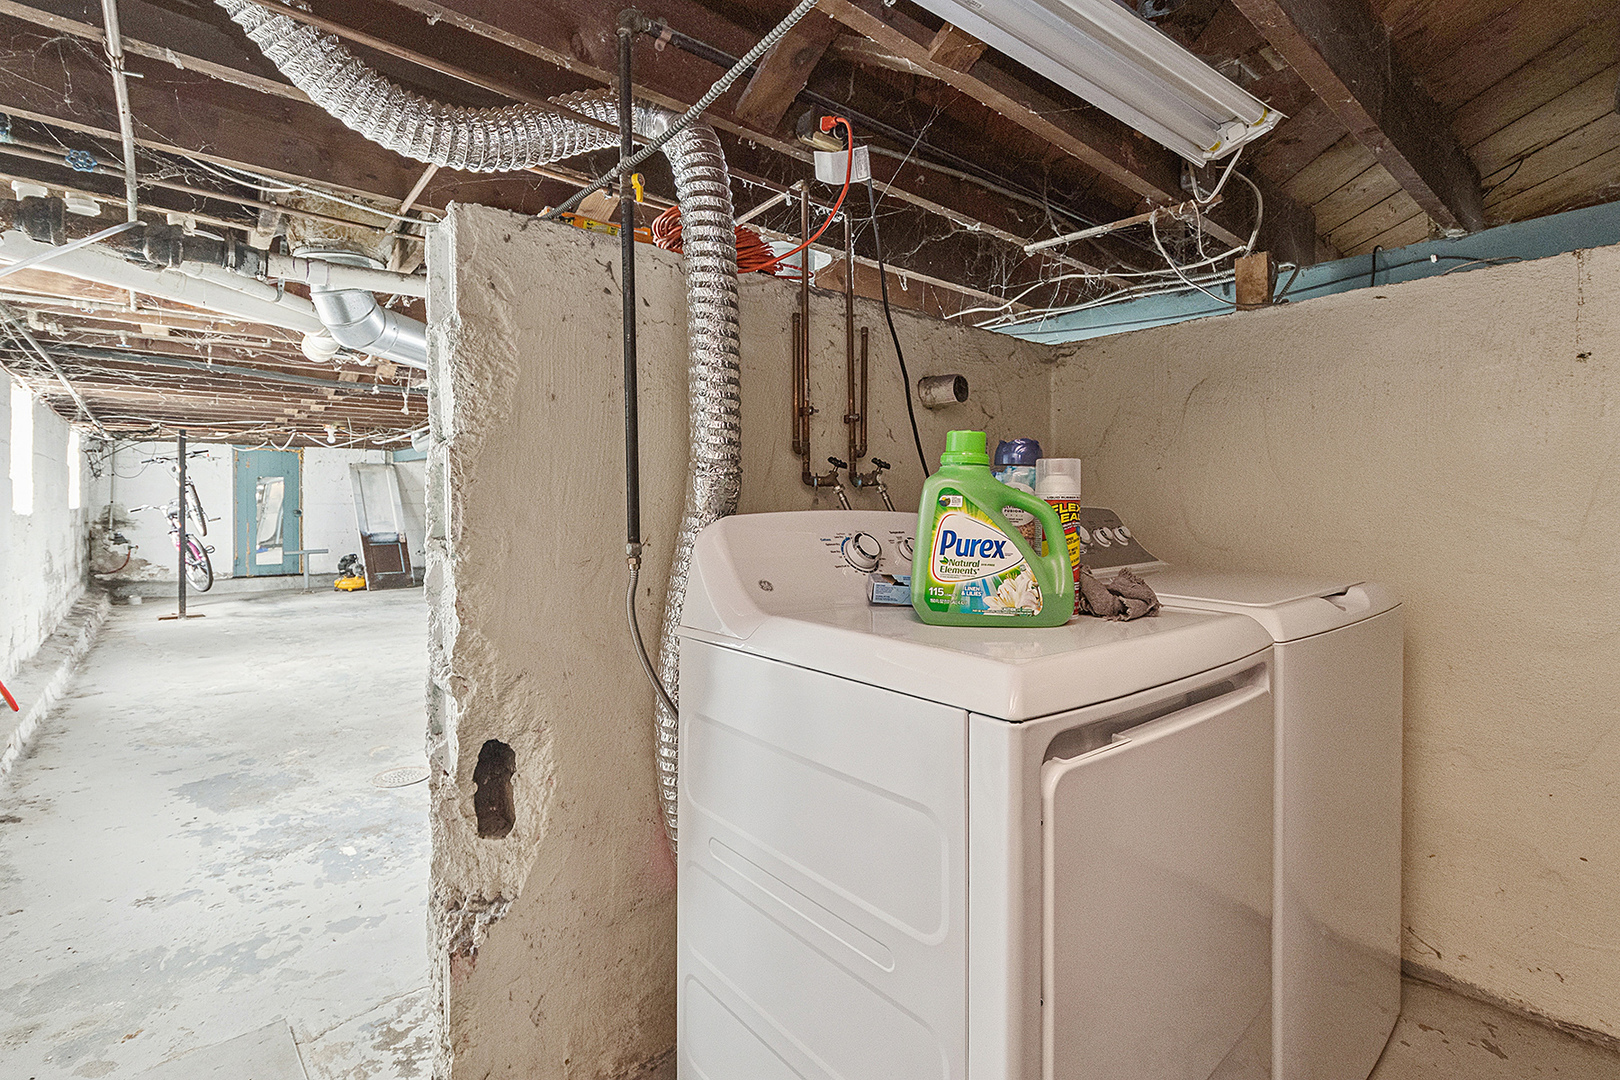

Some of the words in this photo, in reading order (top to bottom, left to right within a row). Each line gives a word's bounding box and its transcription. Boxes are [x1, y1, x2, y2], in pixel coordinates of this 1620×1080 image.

[1060, 512, 1080, 524] EAL
[939, 530, 1006, 559] Purex
[948, 559, 980, 568] Natural
[928, 587, 945, 596] 115
